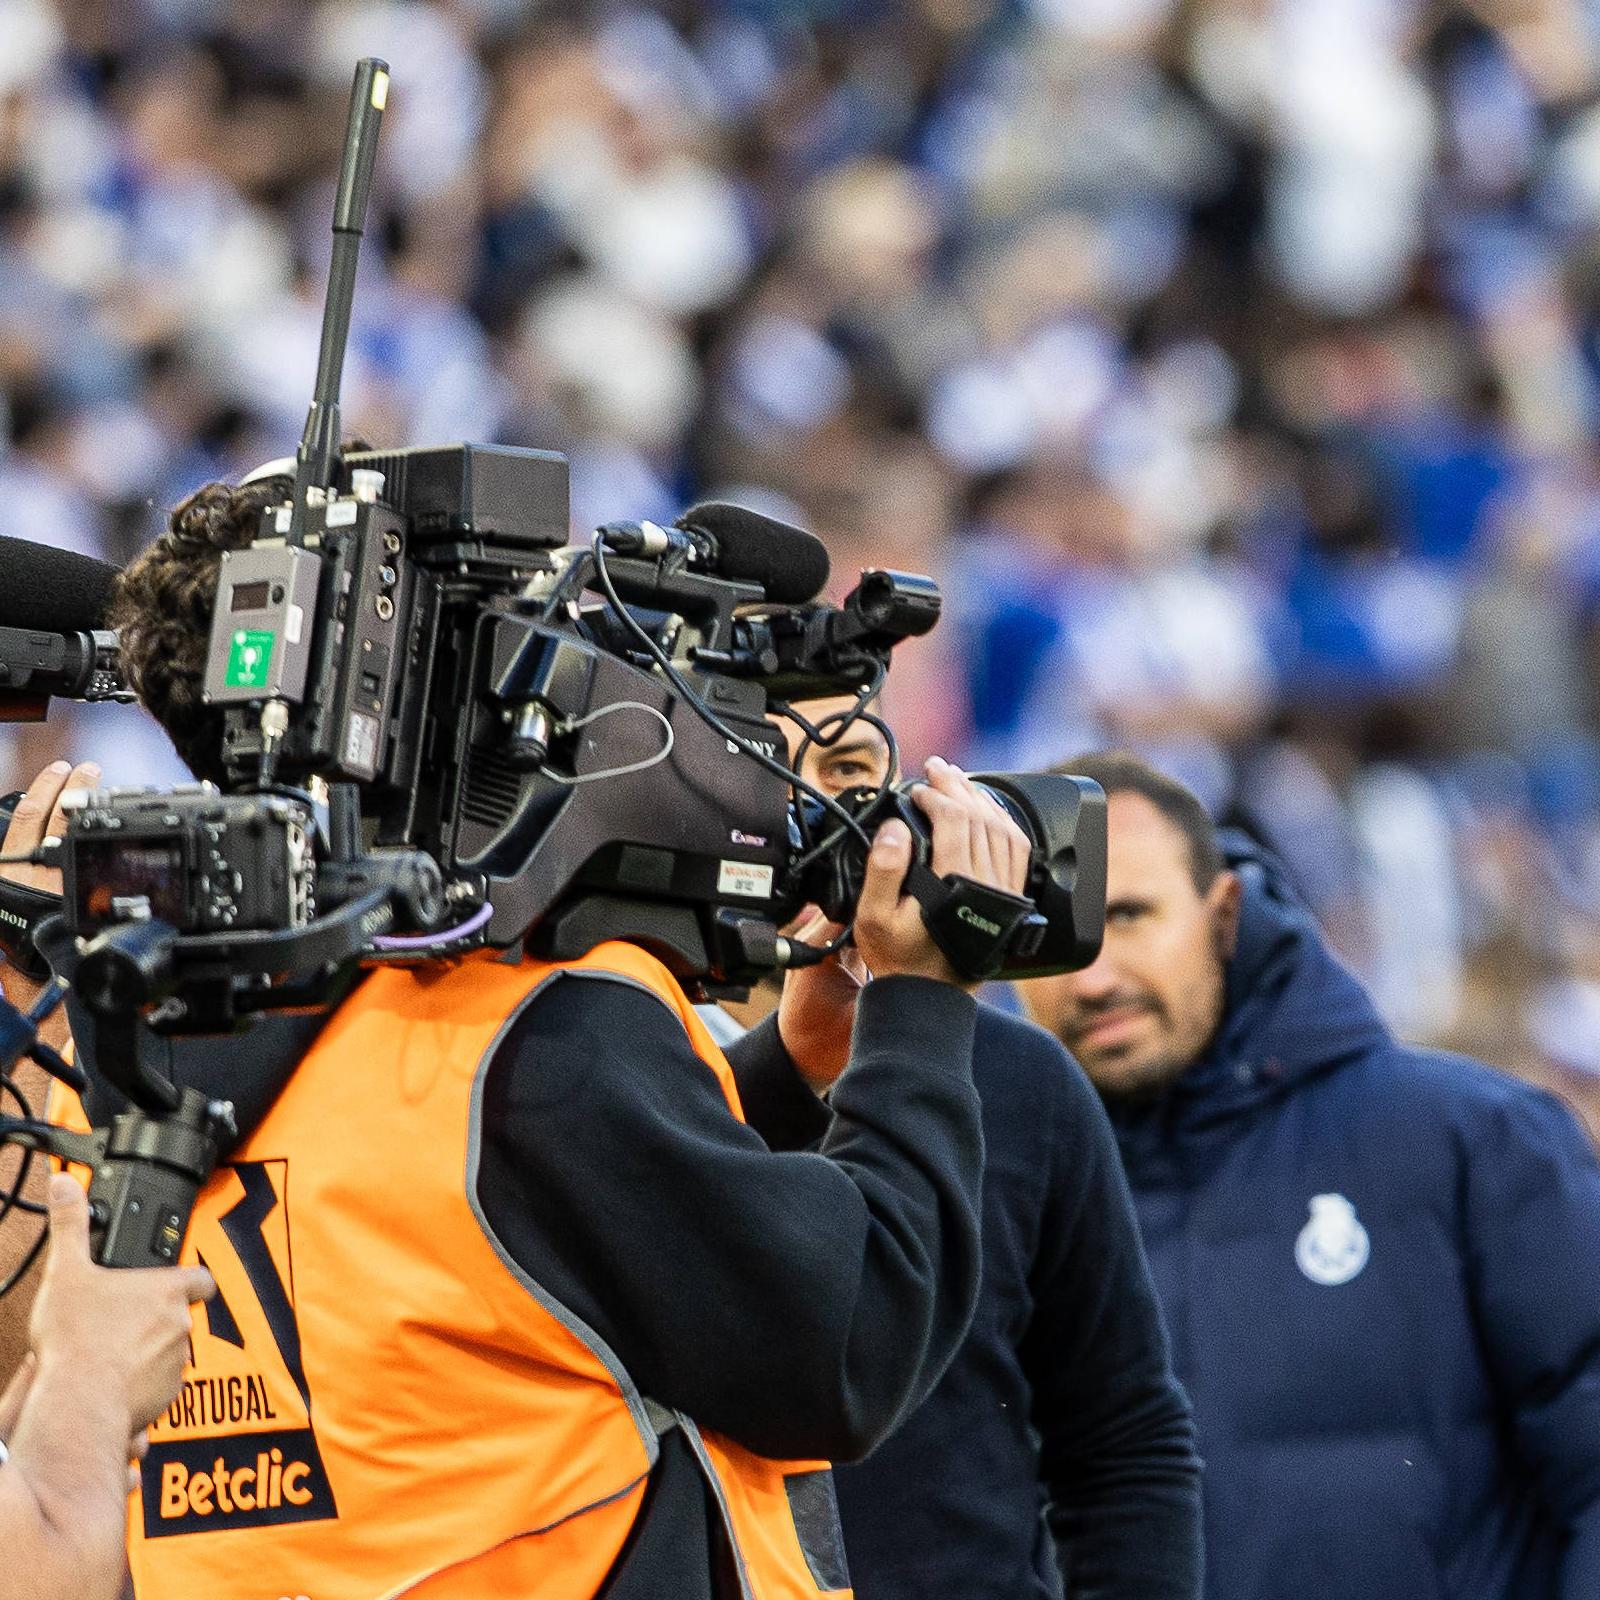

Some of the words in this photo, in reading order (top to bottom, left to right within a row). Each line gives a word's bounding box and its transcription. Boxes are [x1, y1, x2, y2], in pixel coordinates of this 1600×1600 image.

[0, 909, 28, 929] non
[957, 906, 1001, 937] Canon
[153, 1374, 277, 1430] ORTUGAL
[160, 1448, 314, 1519] Betclic
